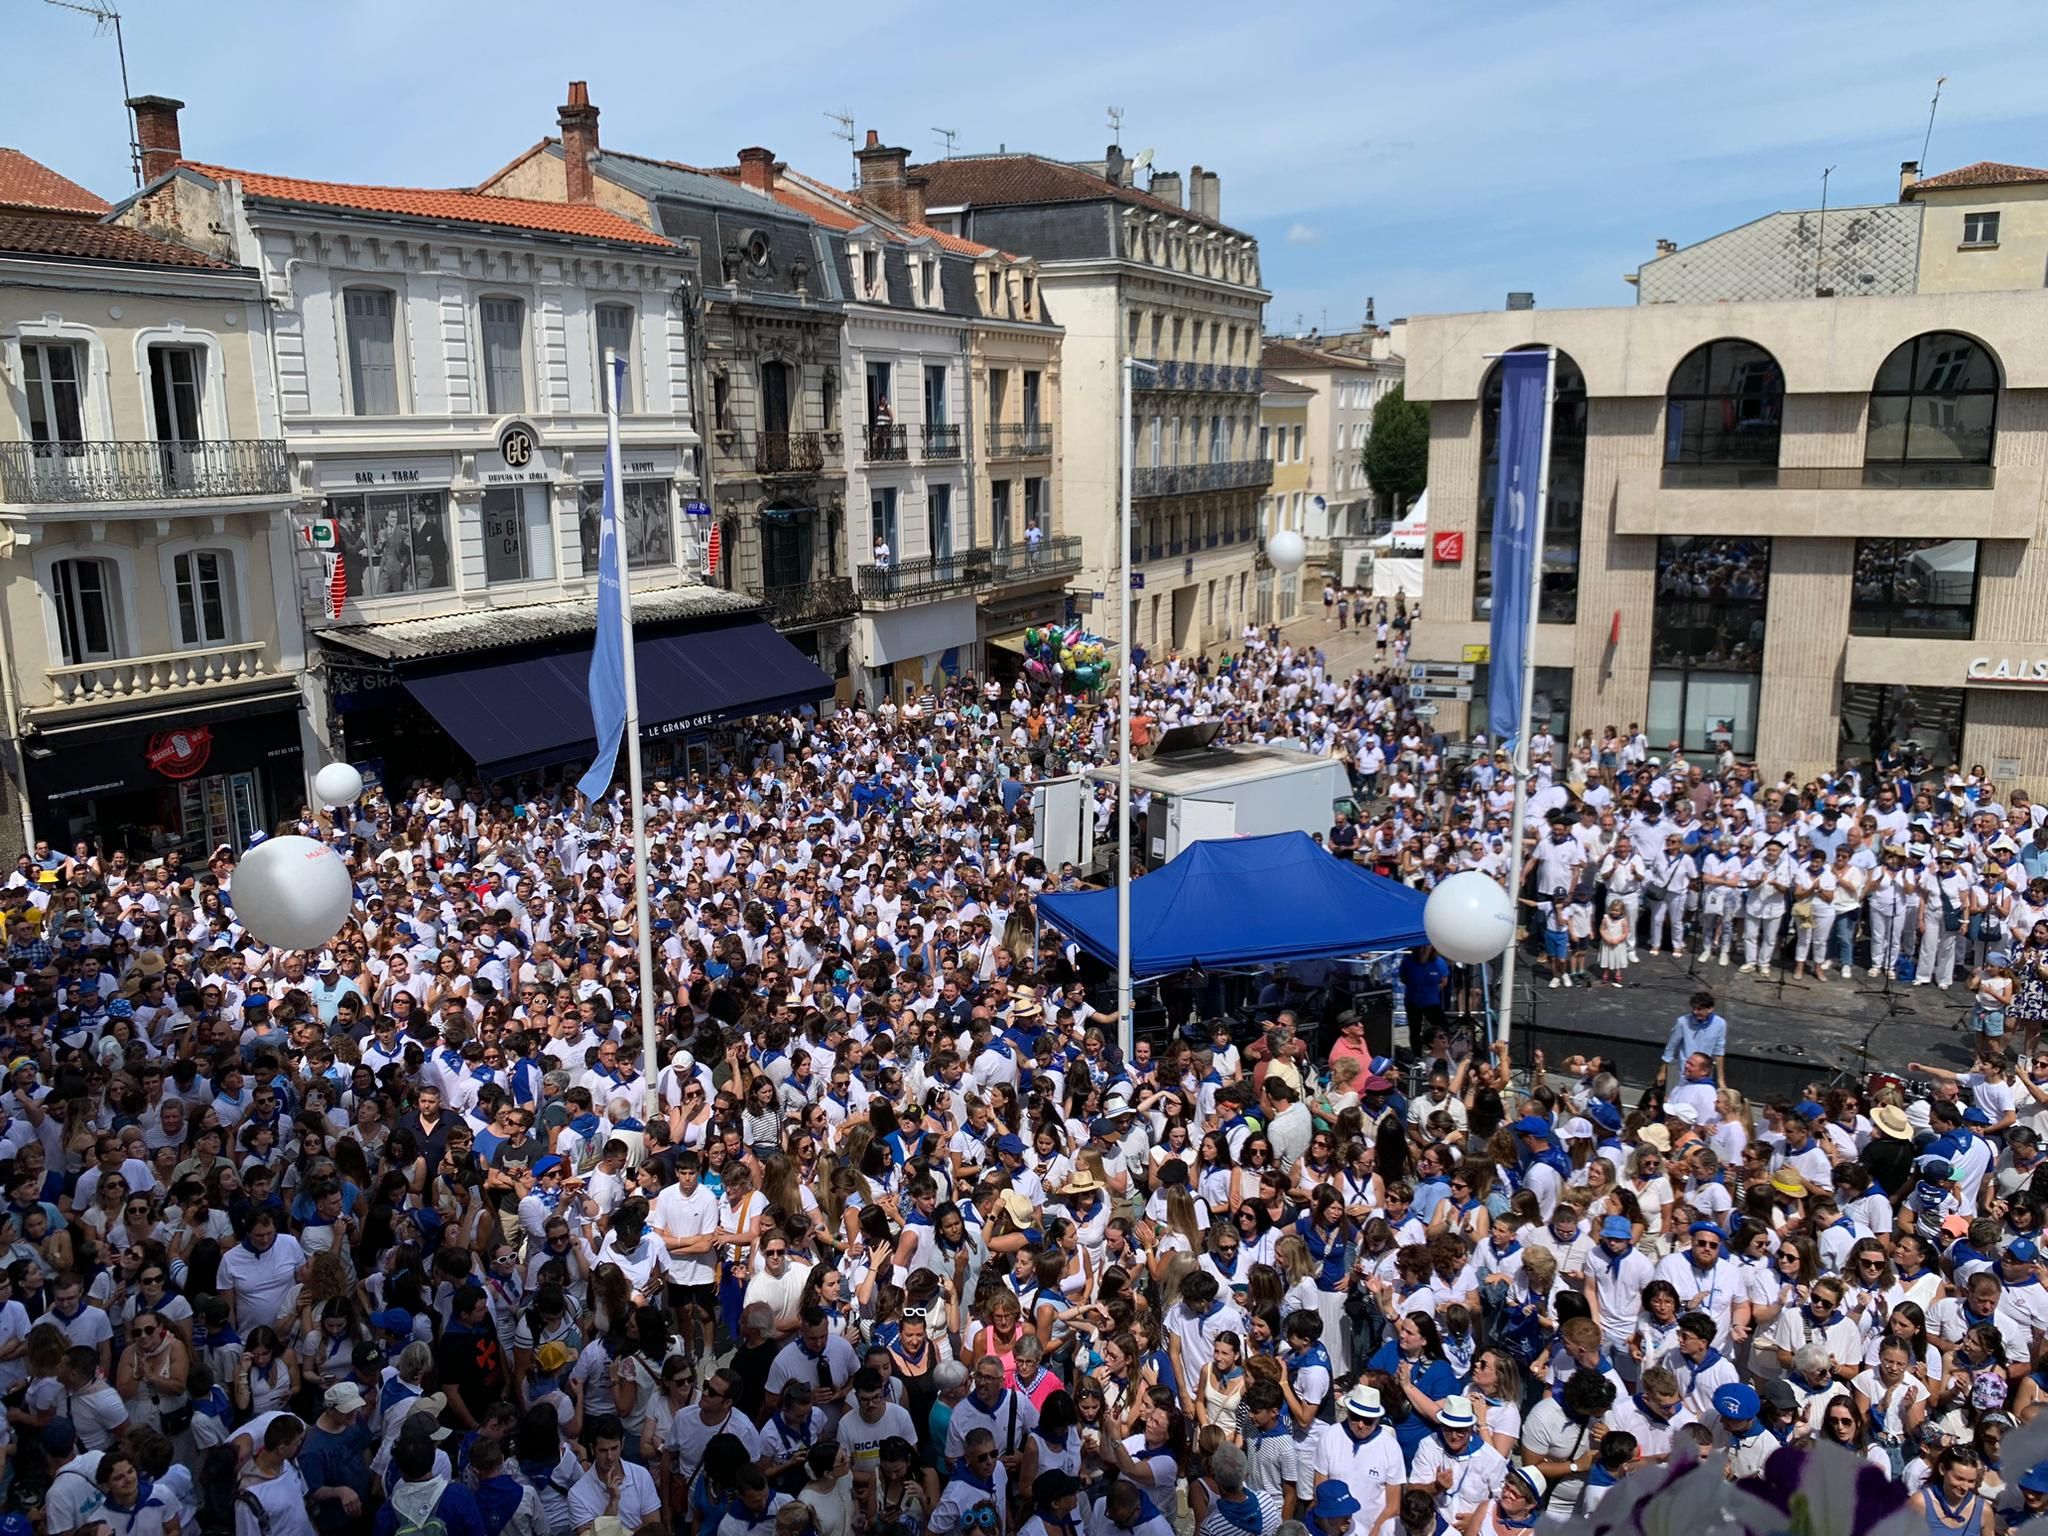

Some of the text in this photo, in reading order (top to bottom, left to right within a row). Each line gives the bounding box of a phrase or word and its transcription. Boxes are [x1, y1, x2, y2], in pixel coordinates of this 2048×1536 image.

[631, 461, 655, 472] VAPOTE
[355, 470, 420, 485] BAR TABAC
[649, 727, 660, 738] LE
[662, 720, 691, 734] GRAND
